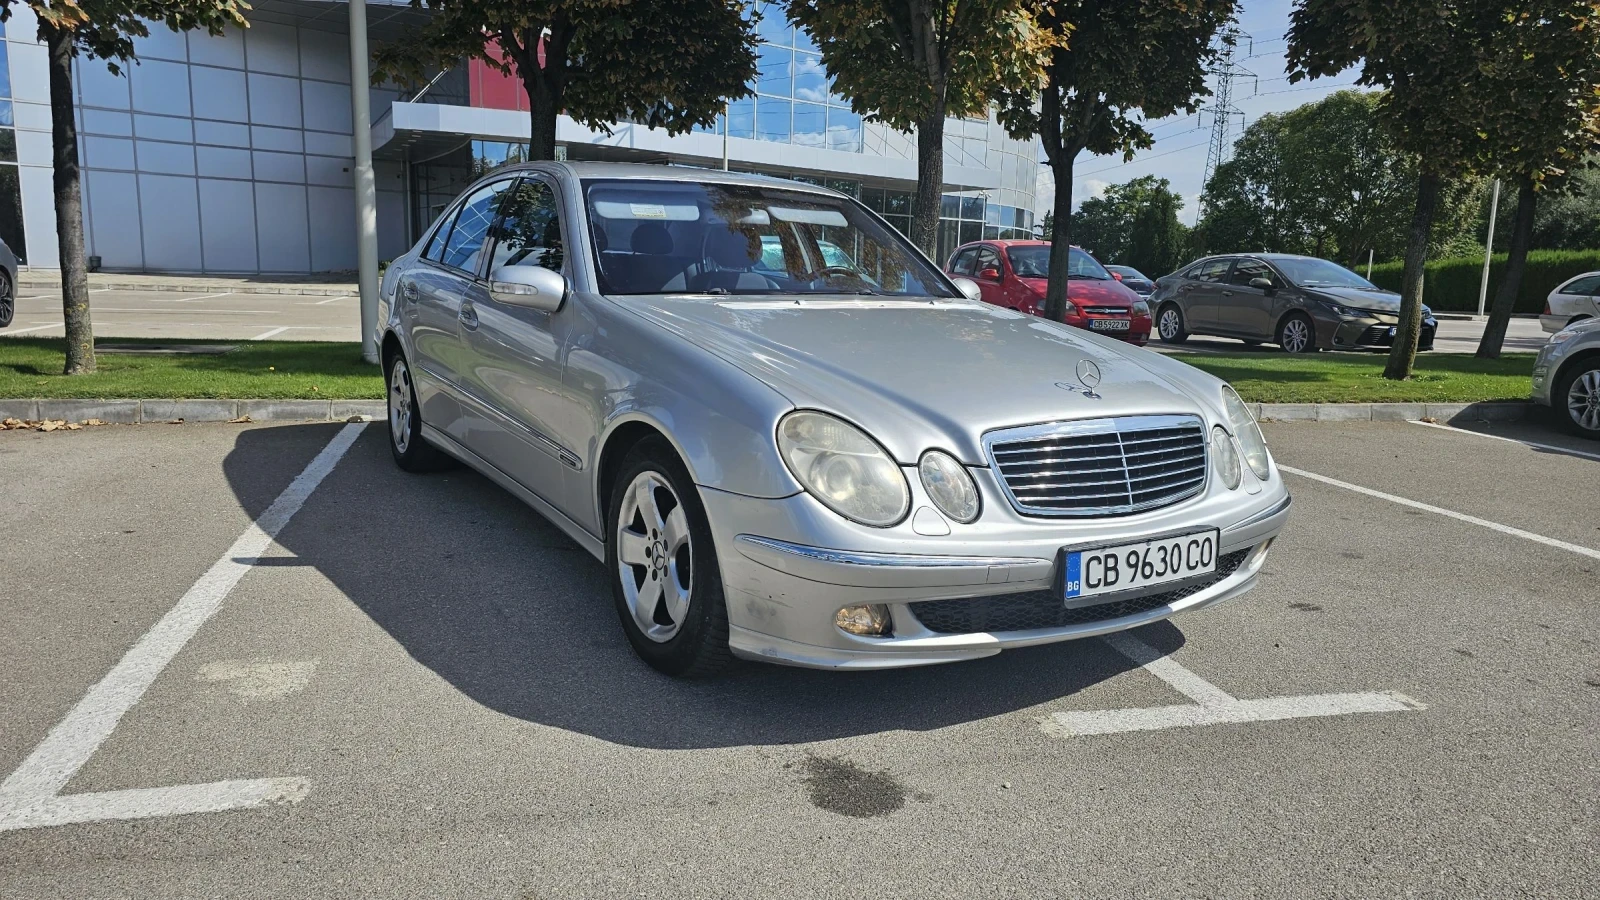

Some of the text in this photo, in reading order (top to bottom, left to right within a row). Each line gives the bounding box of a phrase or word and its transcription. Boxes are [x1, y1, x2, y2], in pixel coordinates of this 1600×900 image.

[1085, 536, 1213, 589] CB 9630 CO
[1067, 580, 1080, 592] BG
